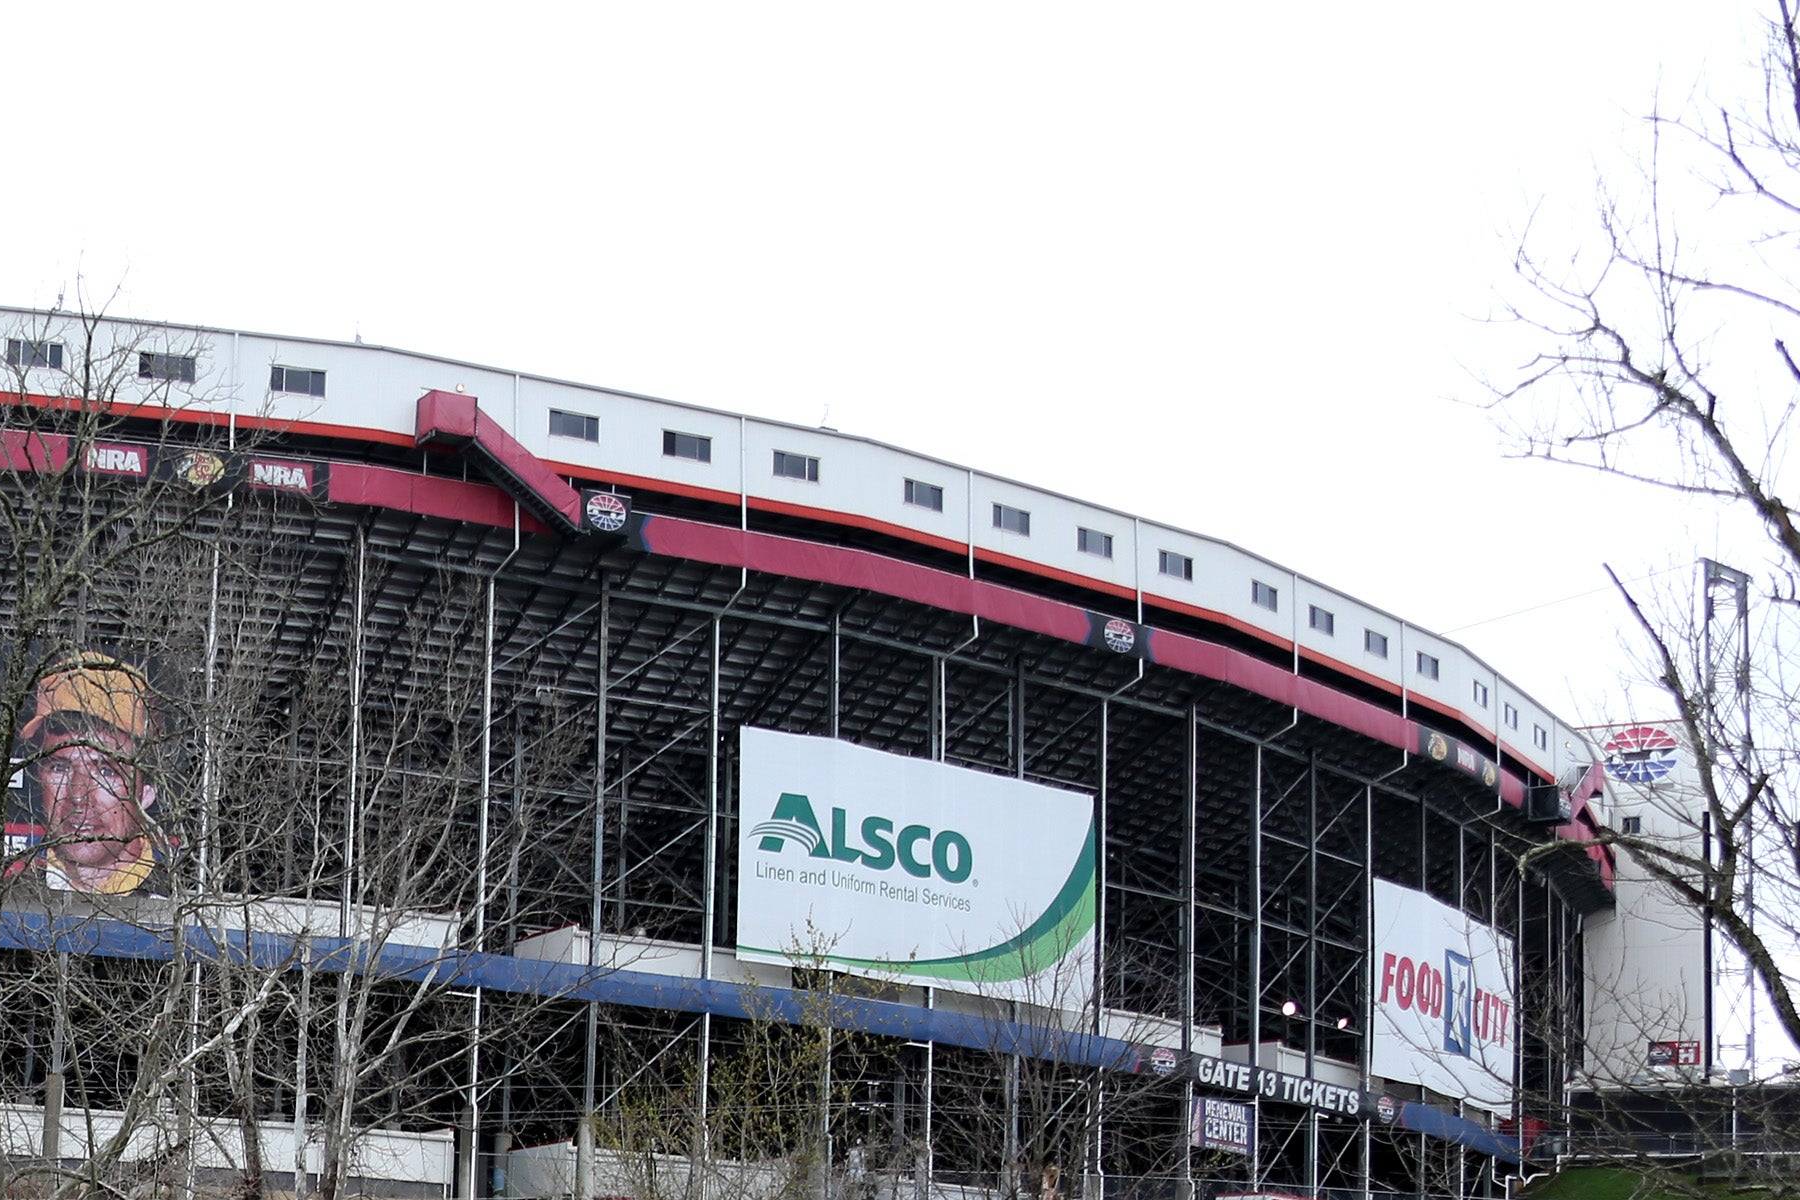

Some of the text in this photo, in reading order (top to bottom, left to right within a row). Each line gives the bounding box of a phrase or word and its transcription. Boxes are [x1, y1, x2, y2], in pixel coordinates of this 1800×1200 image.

[86, 448, 142, 473] NRA
[253, 463, 308, 489] NRA
[753, 792, 973, 884] ALSCO
[755, 861, 972, 912] Linen and Uniform Rental Services
[1379, 952, 1443, 1019] FOOD
[1472, 987, 1510, 1049] CITY
[1678, 1048, 1695, 1064] H
[1199, 1057, 1360, 1116] GATE 13 TICKETS
[1205, 1100, 1248, 1124] RENEWAL
[1205, 1117, 1248, 1146] CENTER
